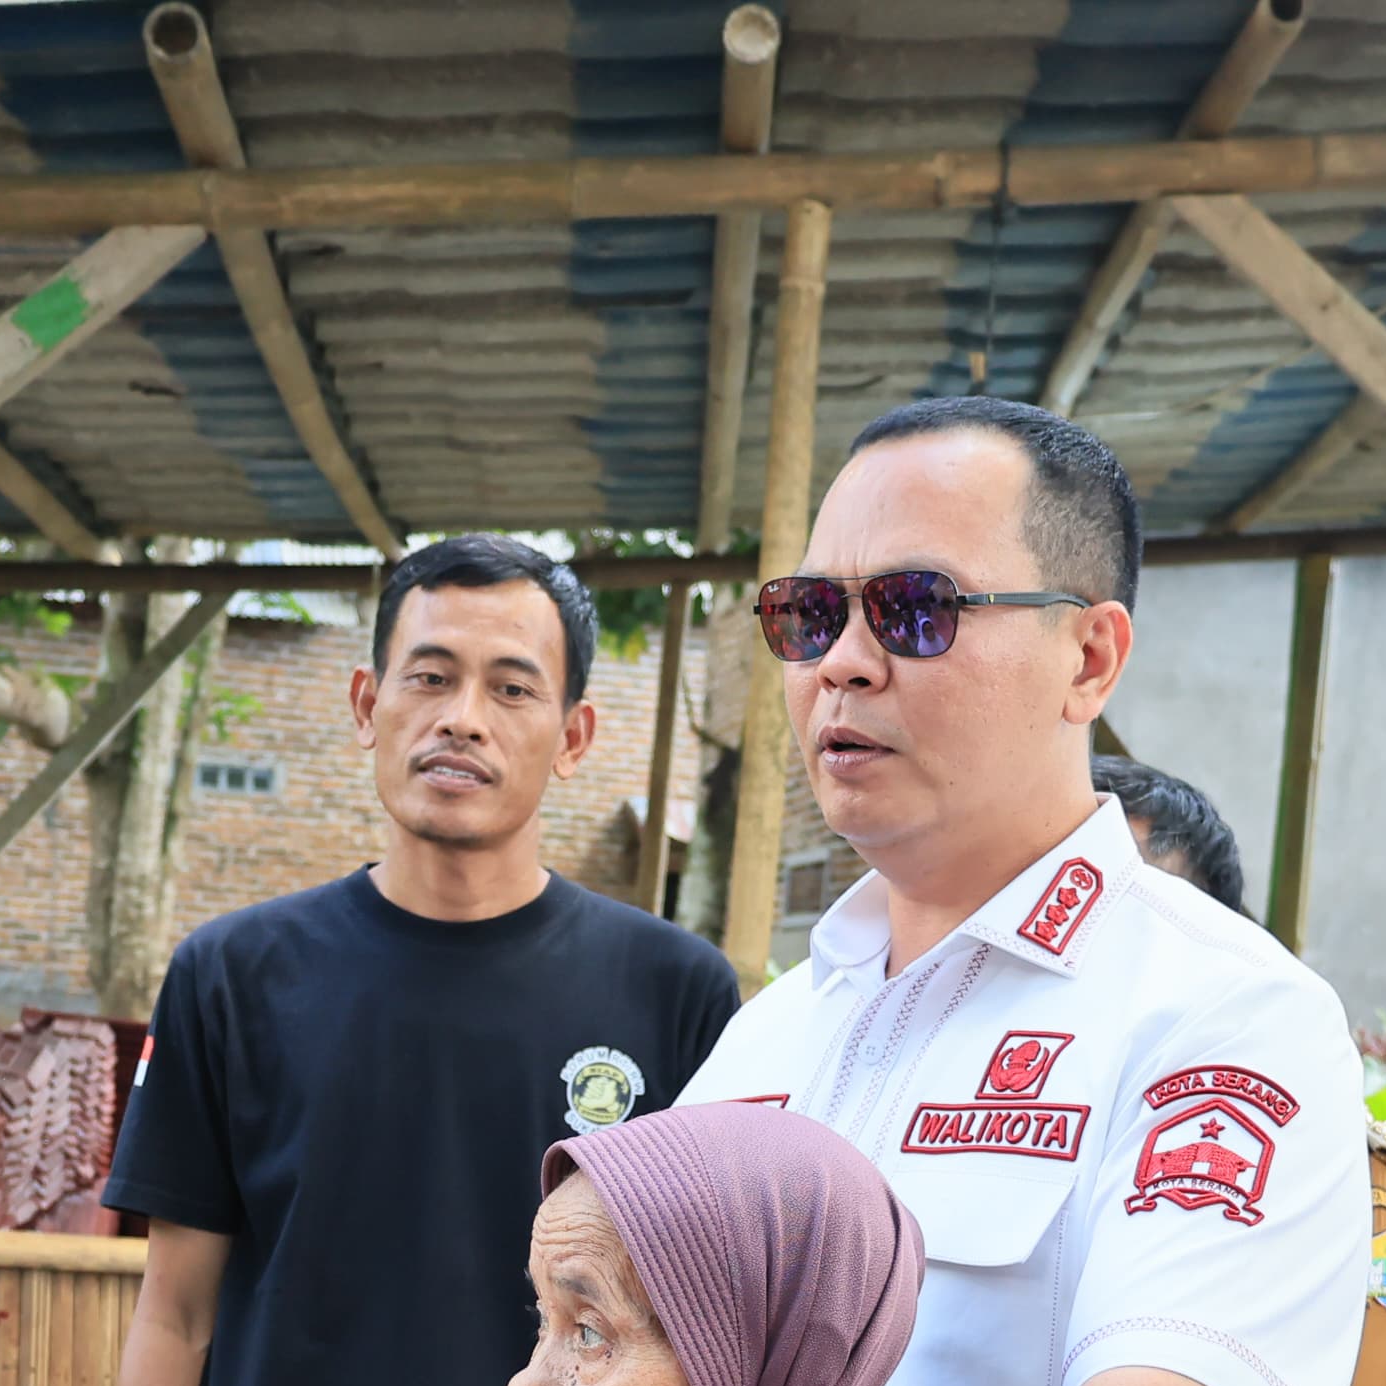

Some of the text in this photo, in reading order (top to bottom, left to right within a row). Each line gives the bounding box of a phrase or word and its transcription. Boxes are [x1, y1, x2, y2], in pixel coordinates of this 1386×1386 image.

[1154, 1071, 1290, 1116] KOTA SERANG
[917, 1111, 1068, 1149] WALIKOTA
[1152, 1178, 1241, 1200] KOTA SERANG
